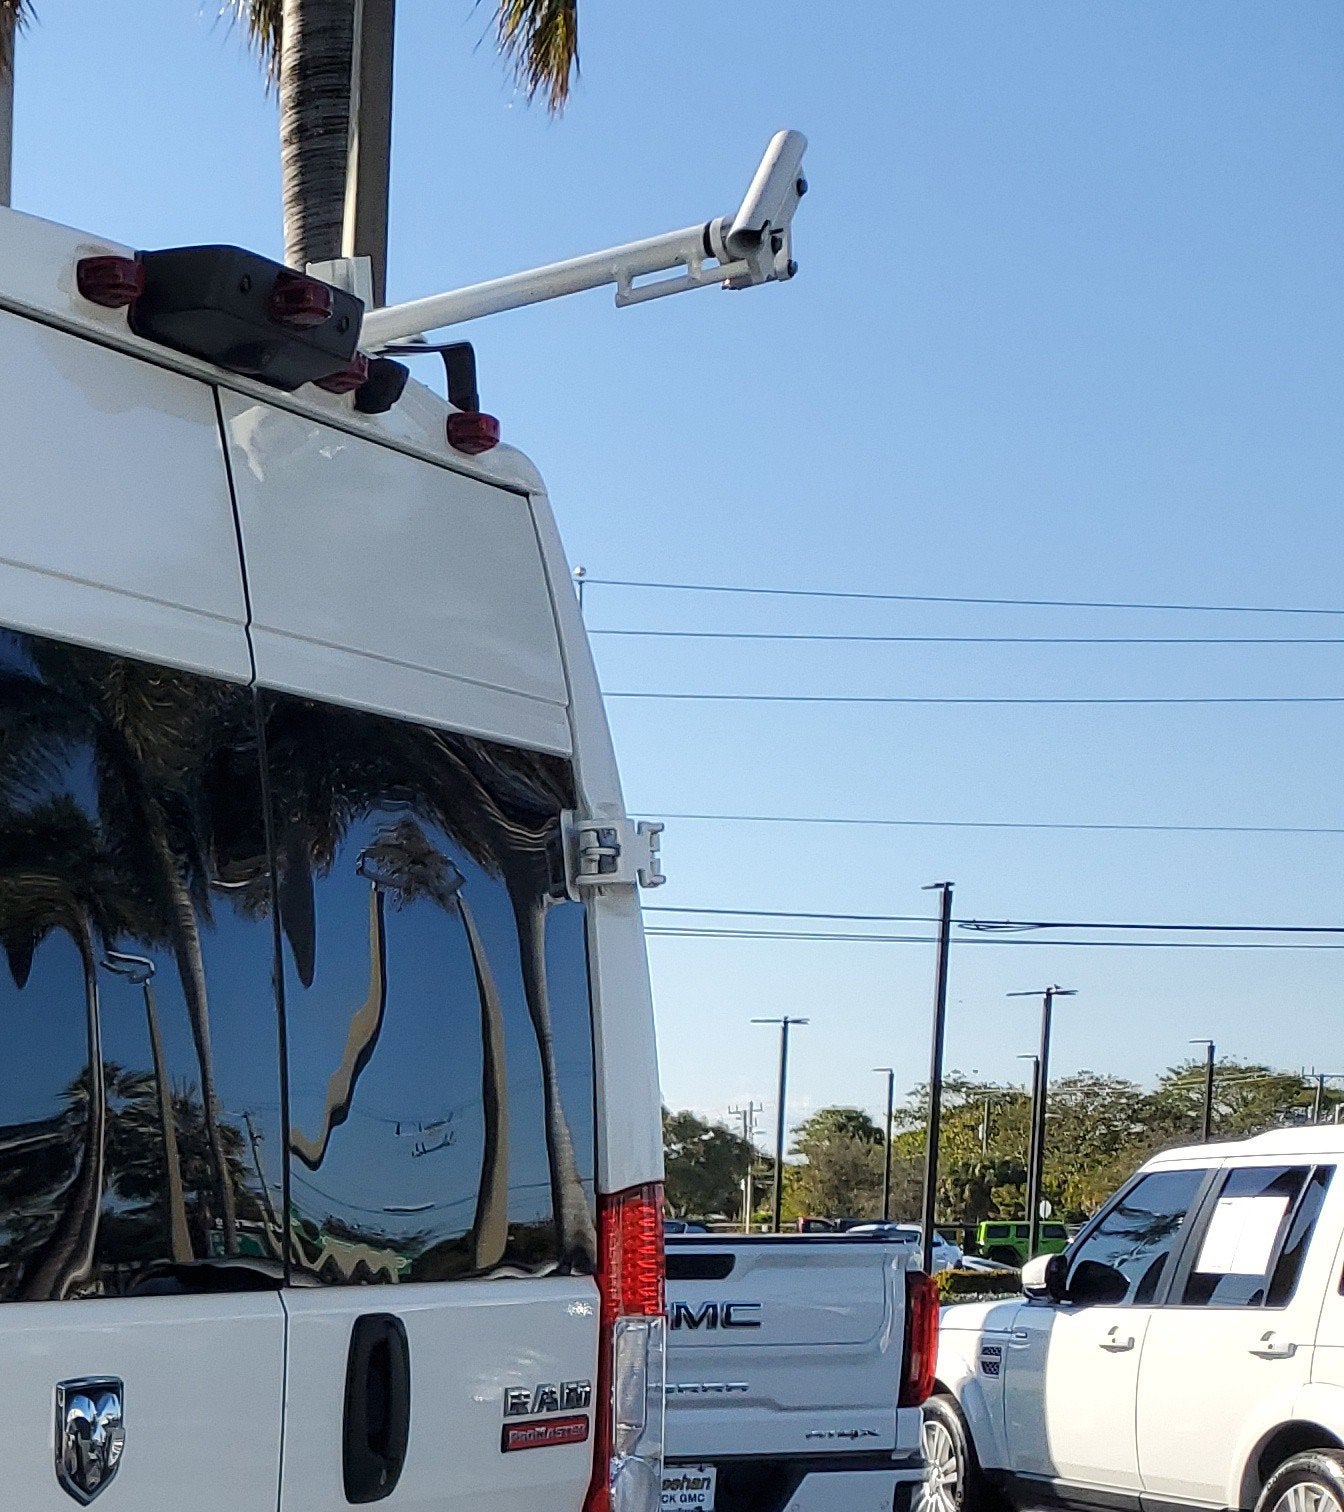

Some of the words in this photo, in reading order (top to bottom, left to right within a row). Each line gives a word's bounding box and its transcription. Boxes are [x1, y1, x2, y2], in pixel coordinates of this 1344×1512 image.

[666, 1300, 764, 1330] MC
[503, 1380, 592, 1418] RAM
[679, 1493, 706, 1503] GMC
